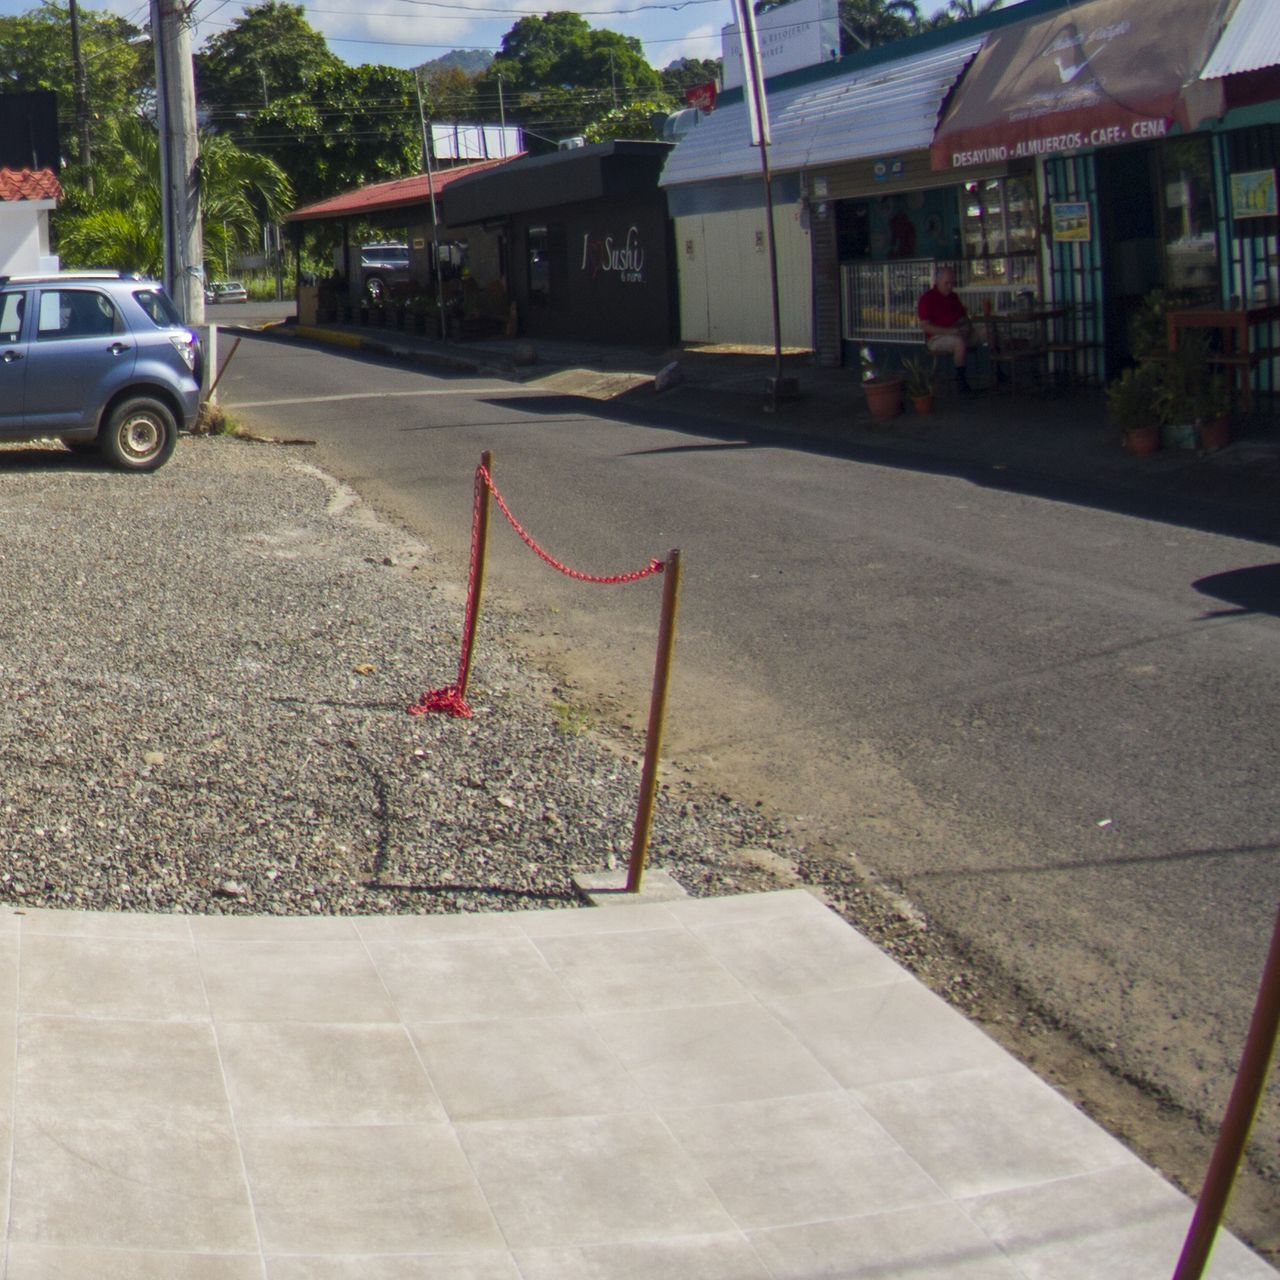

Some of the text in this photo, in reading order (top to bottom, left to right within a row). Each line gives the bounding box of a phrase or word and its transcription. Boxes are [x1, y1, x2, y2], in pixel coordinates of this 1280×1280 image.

[952, 119, 1166, 168] DESAYUNO ALMUERZOS CAFE CENA
[602, 225, 645, 272] Sushi
